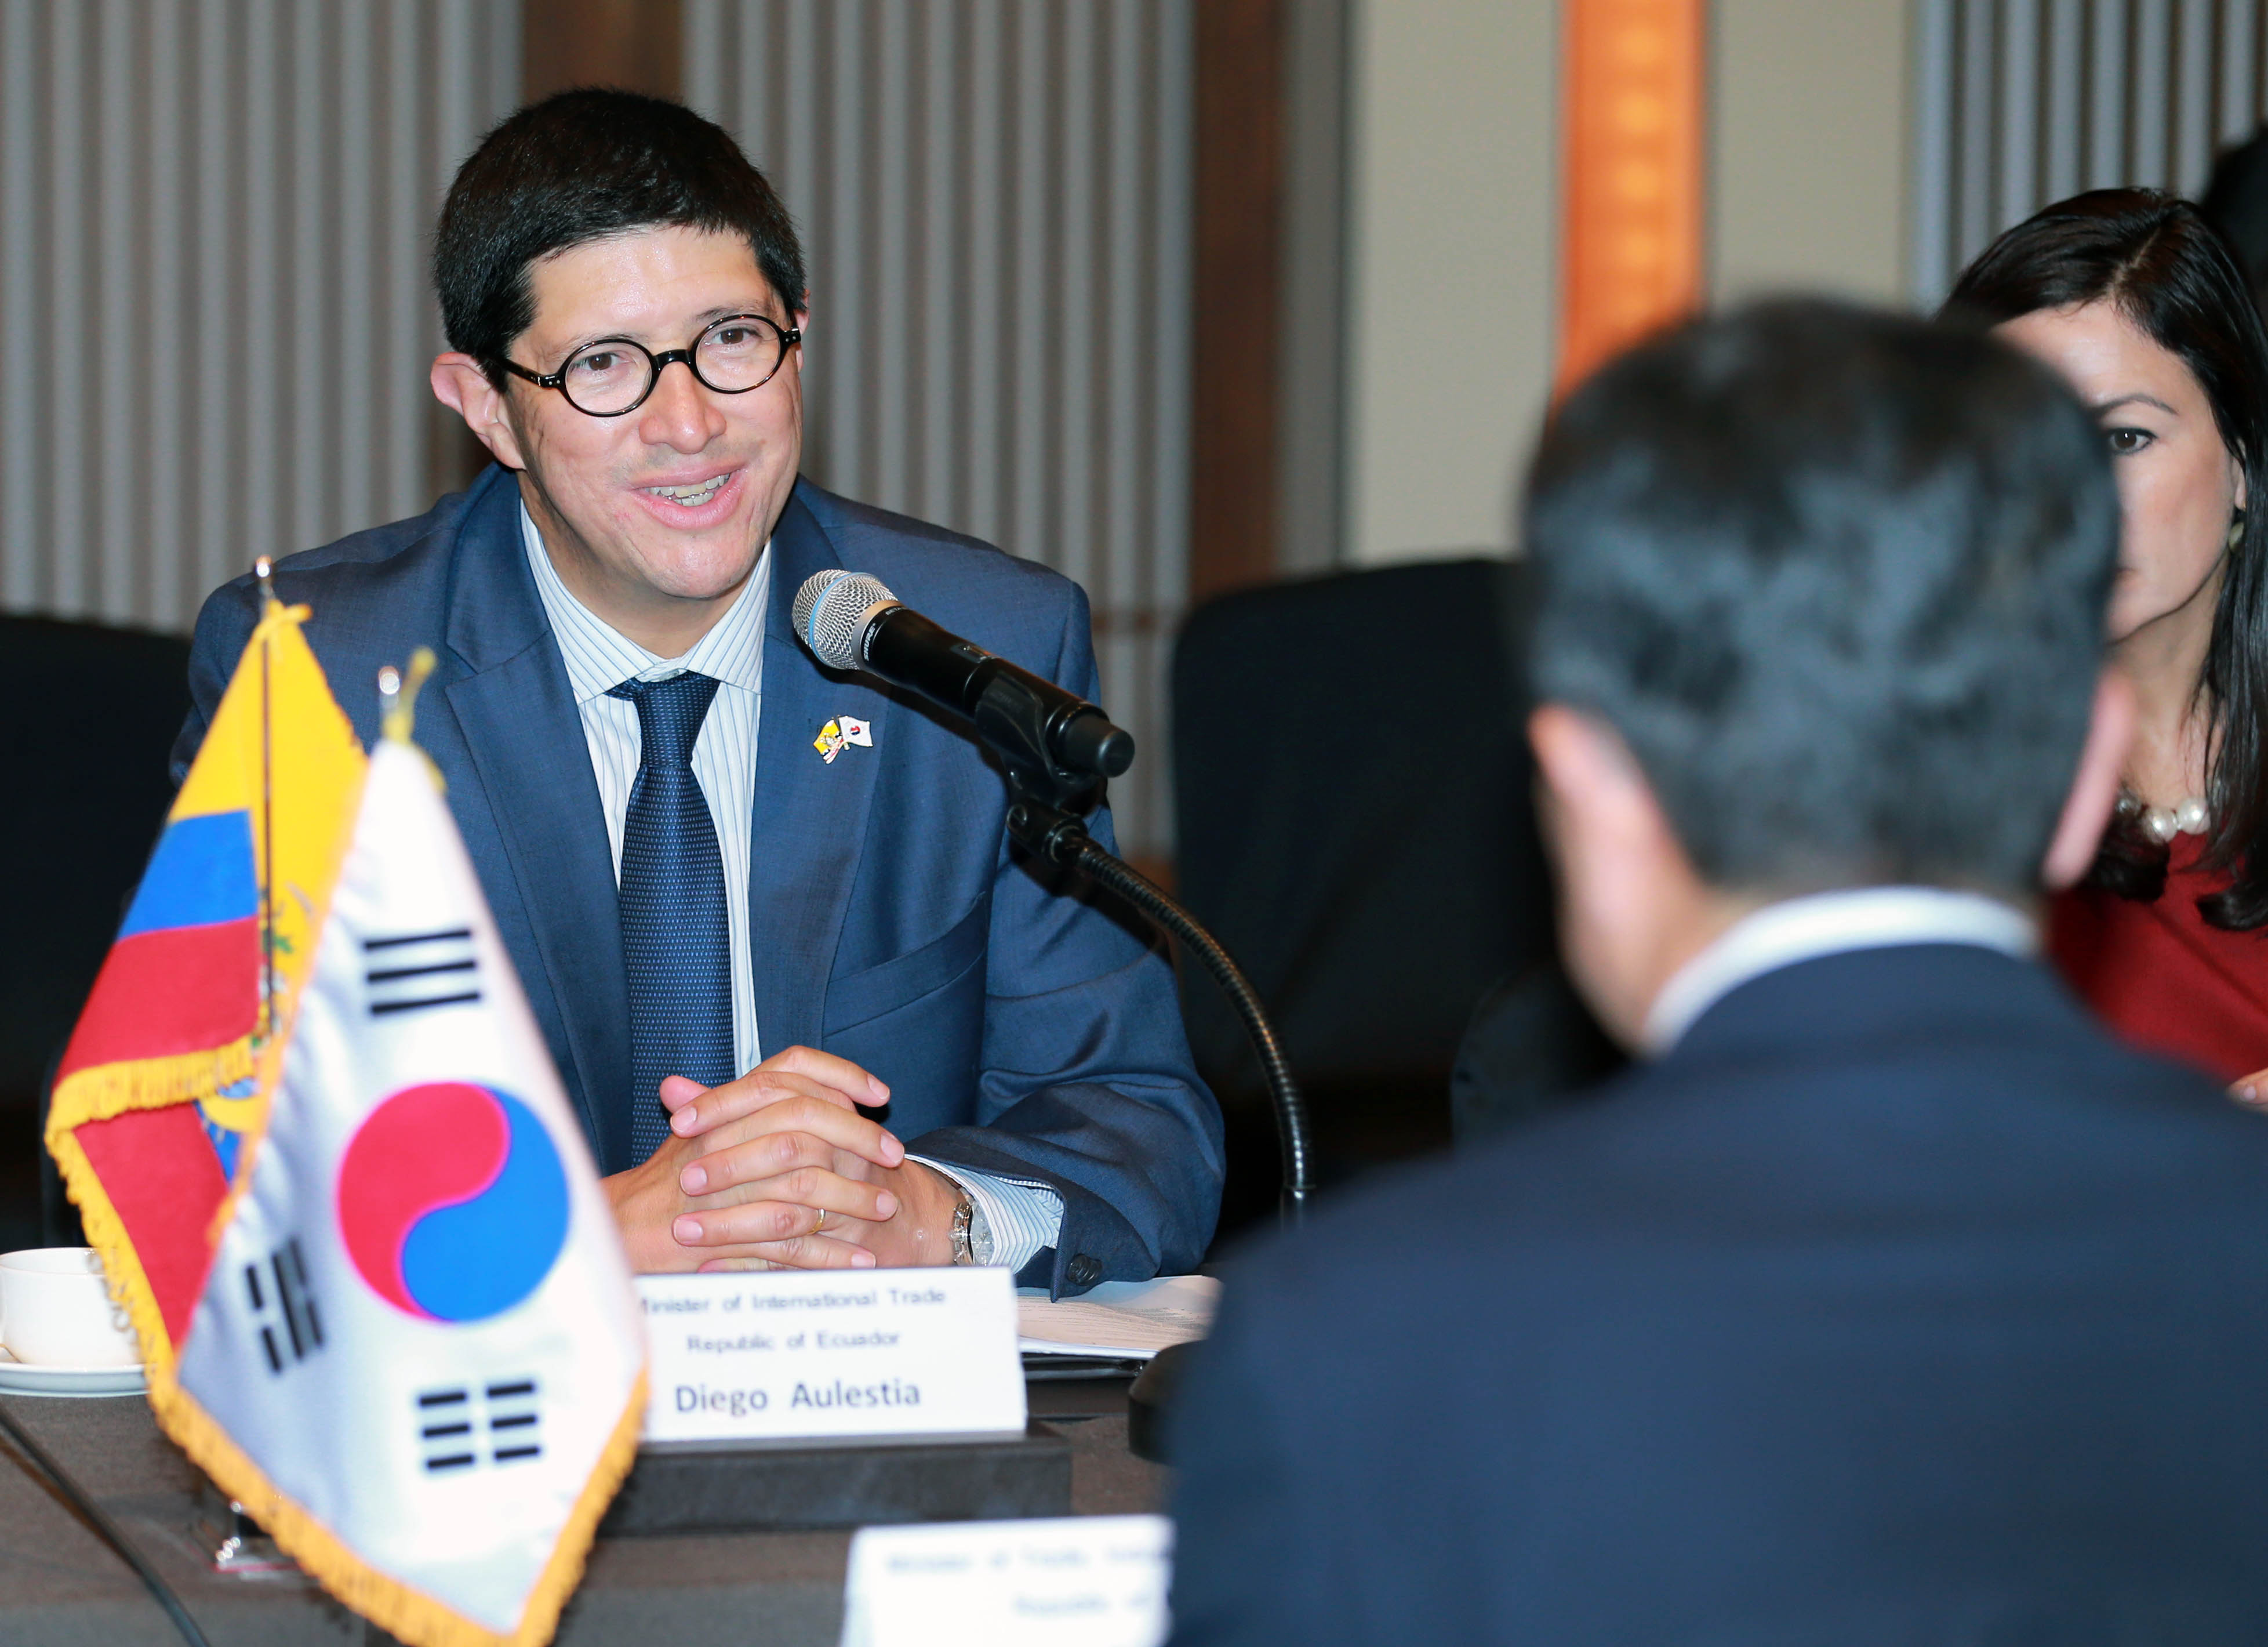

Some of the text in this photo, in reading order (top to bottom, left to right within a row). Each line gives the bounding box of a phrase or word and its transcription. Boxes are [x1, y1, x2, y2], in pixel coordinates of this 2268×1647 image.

[863, 626, 875, 661] SHURE
[723, 1293, 742, 1312] of
[753, 1290, 878, 1309] International
[890, 1288, 946, 1306] Trade
[687, 1331, 900, 1355] Republic of Ecuador
[675, 1378, 921, 1417] Diego Aulestia
